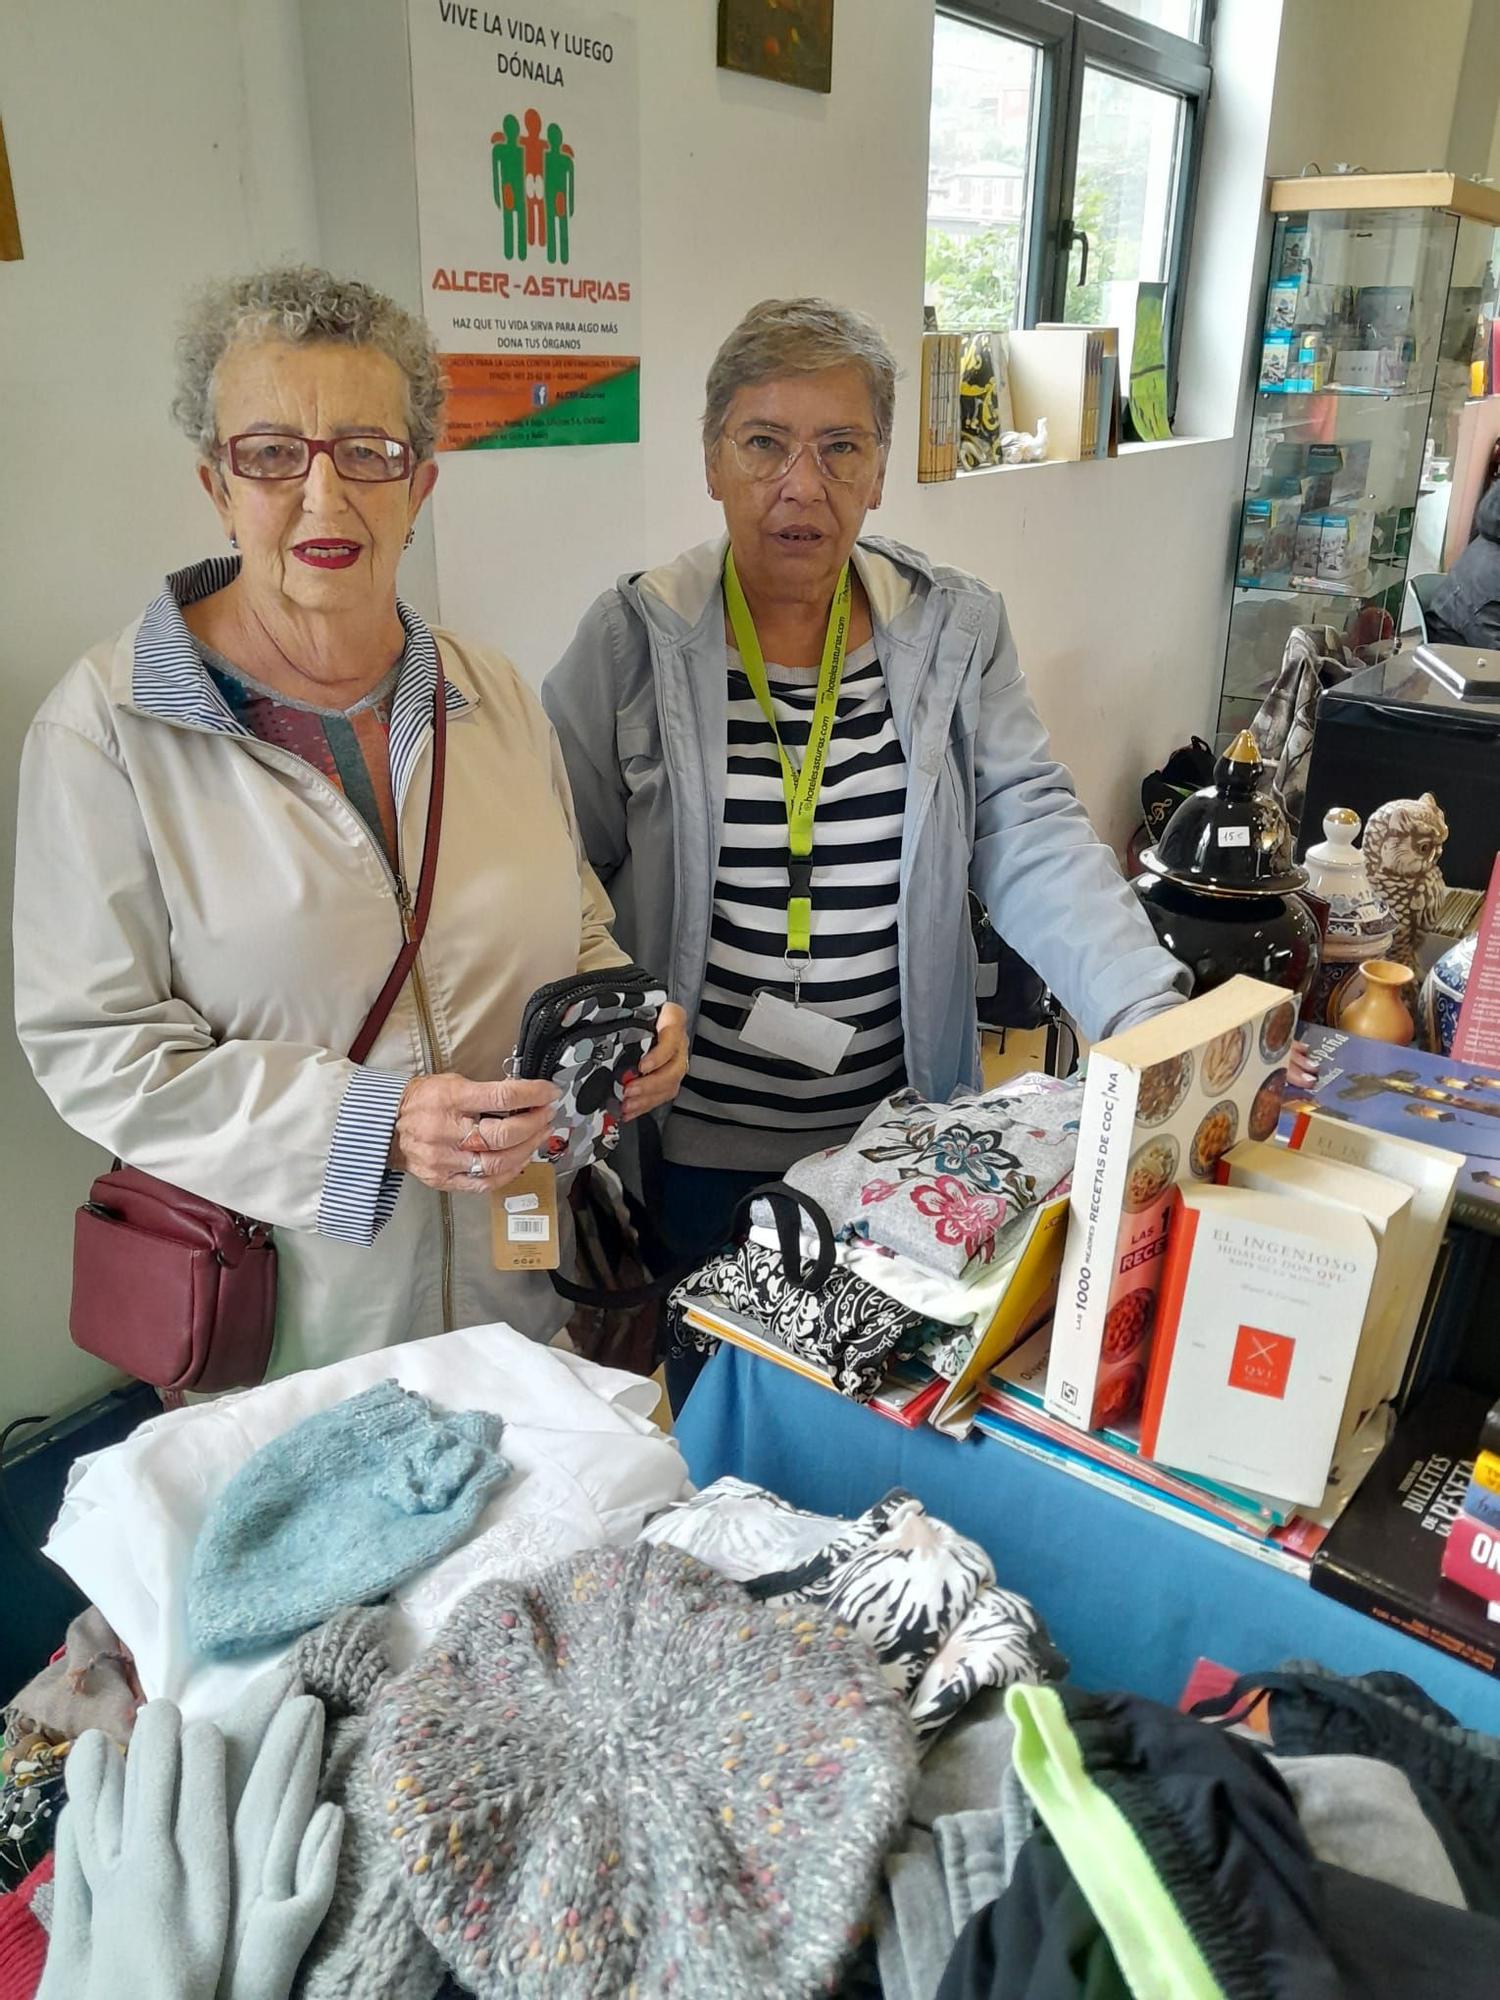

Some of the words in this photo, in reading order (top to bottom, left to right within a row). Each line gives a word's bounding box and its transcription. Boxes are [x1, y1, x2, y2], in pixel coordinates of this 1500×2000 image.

[438, 0, 477, 30] VIVE
[484, 12, 502, 36] LA
[506, 18, 546, 47] VIDA
[550, 29, 560, 50] Y
[564, 33, 614, 63] LUEGO
[497, 52, 564, 87] DÓNALA
[453, 317, 471, 329] HAZ
[473, 318, 492, 330] QUE
[495, 319, 506, 330] TU
[508, 320, 528, 331] VIDA
[530, 320, 552, 332] SIRVA
[555, 322, 576, 332] PARA
[578, 322, 599, 333] ALGO
[601, 321, 618, 334] MÁS
[497, 337, 522, 348] DONA
[525, 338, 540, 349] TUS
[542, 335, 581, 349] ÓRGANOS
[1076, 1267, 1091, 1310] 1000
[1089, 1159, 1106, 1223] RECETAS
[1098, 1136, 1109, 1155] DE
[1131, 1226, 1154, 1245] LAS
[1121, 1240, 1166, 1271] RECE
[1213, 1229, 1233, 1243] EL
[1244, 1235, 1358, 1274] INGENIOSO
[1402, 1454, 1451, 1514] BILLETES
[1429, 1459, 1475, 1521] PESETA
[1421, 1515, 1439, 1531] DE
[1435, 1523, 1453, 1537] LA
